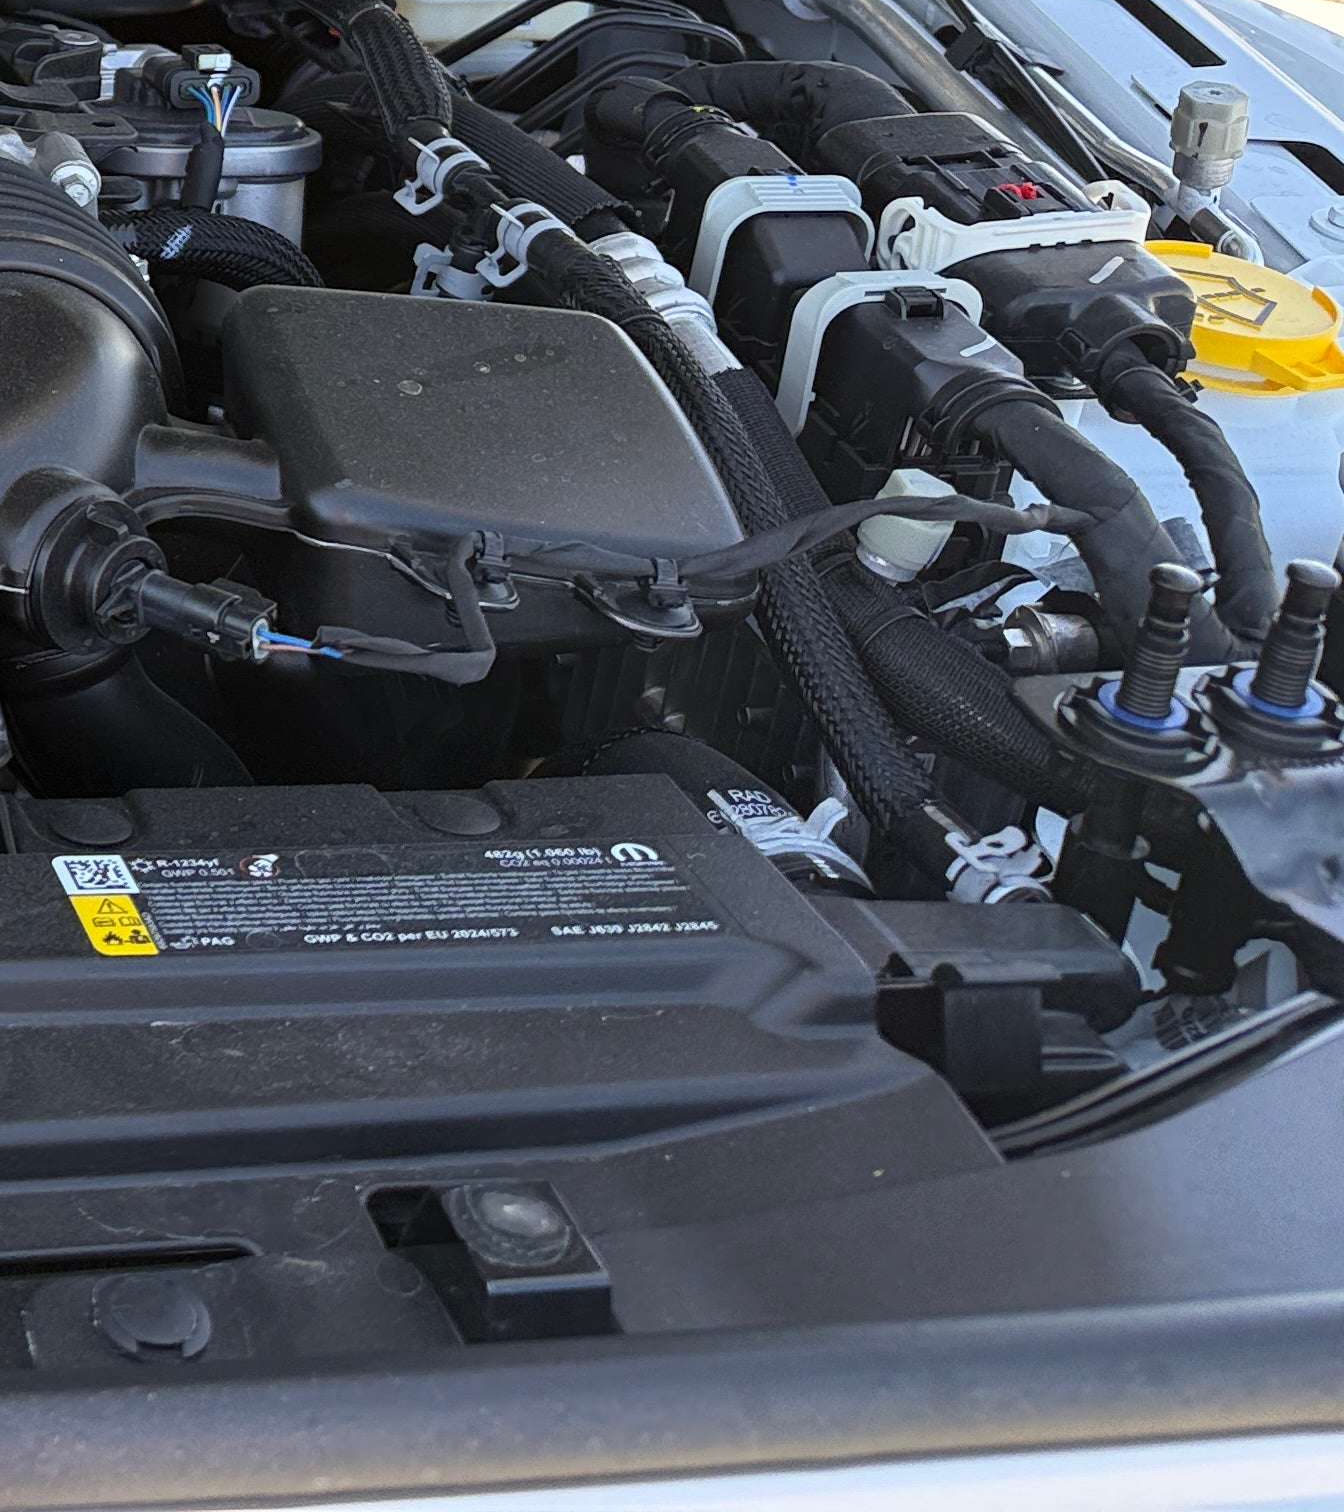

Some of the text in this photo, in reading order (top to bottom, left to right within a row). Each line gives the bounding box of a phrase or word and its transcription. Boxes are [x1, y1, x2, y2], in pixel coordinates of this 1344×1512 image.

[728, 789, 772, 804] RAD
[161, 869, 196, 878] GWP
[550, 926, 585, 936] SAE
[200, 936, 236, 947] PAG
[304, 934, 342, 944] GWP
[346, 933, 358, 942] &
[361, 932, 395, 942] CO2
[398, 933, 422, 942] per
[425, 930, 448, 939] EU
